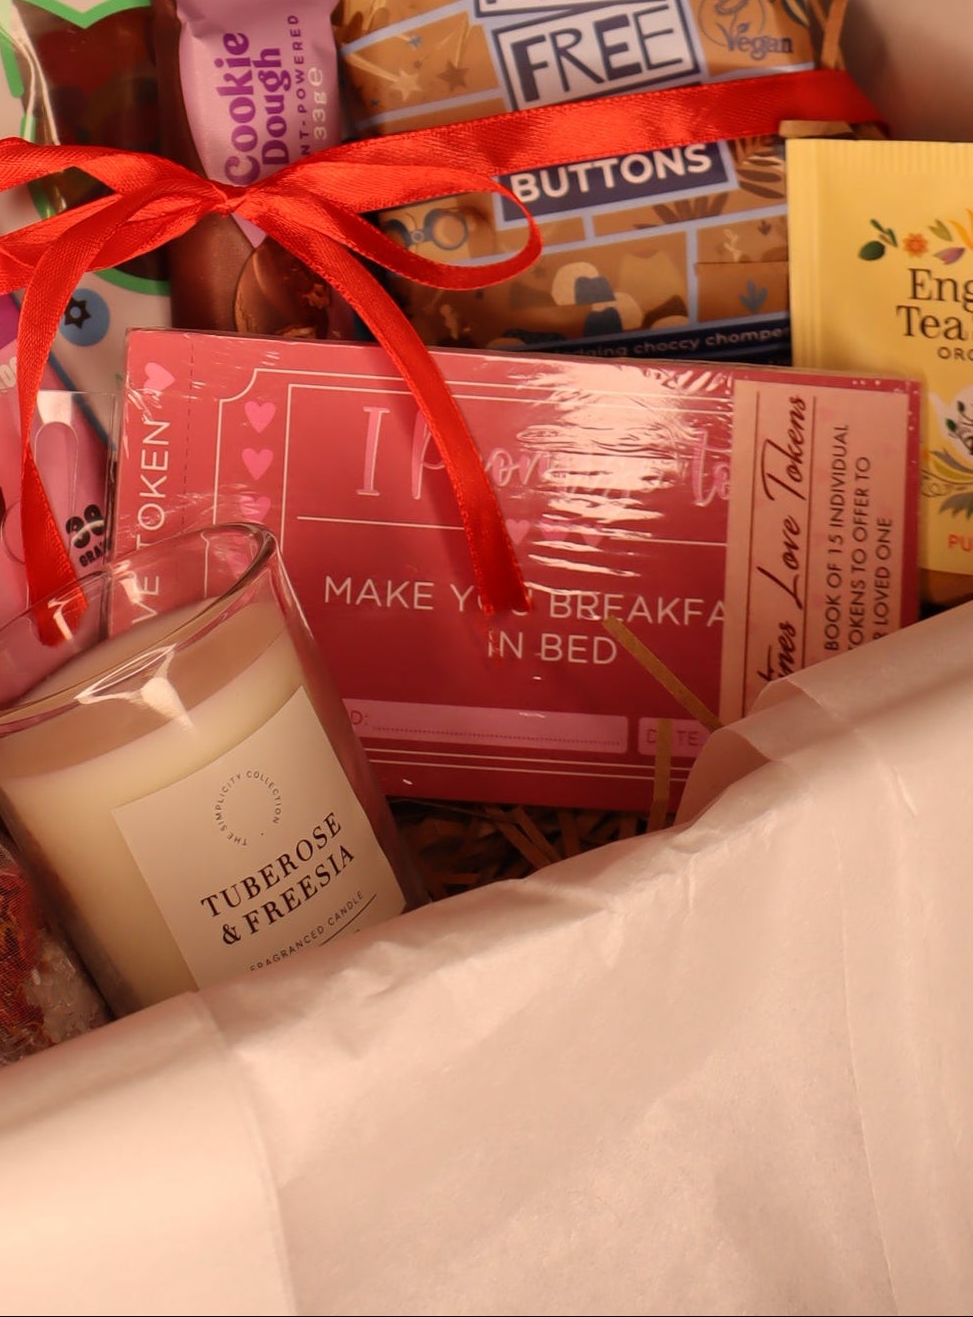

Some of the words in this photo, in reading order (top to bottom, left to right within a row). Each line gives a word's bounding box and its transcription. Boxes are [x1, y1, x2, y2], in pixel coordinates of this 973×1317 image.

[511, 4, 683, 102] FREE
[720, 26, 794, 60] Vegan
[214, 32, 261, 184] Cookie
[252, 47, 291, 165] Dough
[510, 143, 713, 203] BUTTONS
[634, 337, 700, 355] choccy
[895, 304, 967, 341] Tea
[356, 406, 391, 497] I
[761, 394, 807, 501] Tokens
[854, 456, 871, 481] TO
[136, 419, 171, 551] TOKEN
[829, 424, 849, 528] INDIVIDUAL
[852, 488, 869, 543] OFFER
[874, 517, 893, 561] ONE
[756, 515, 803, 610] Love
[827, 534, 845, 556] 15
[851, 547, 868, 574] TO
[324, 575, 434, 611] MAKE
[826, 561, 844, 590] OF
[873, 566, 891, 626] LOVED
[488, 630, 524, 660] IN
[540, 633, 618, 665] BED
[824, 594, 843, 651] BOOK
[214, 773, 241, 832] SIMPLICITY
[246, 770, 282, 824] COLLECTION
[200, 811, 343, 918] TUBEROSE
[227, 831, 248, 846] THE
[221, 923, 241, 946] &
[241, 844, 355, 935] FREESIA
[327, 890, 364, 926] CANDLE
